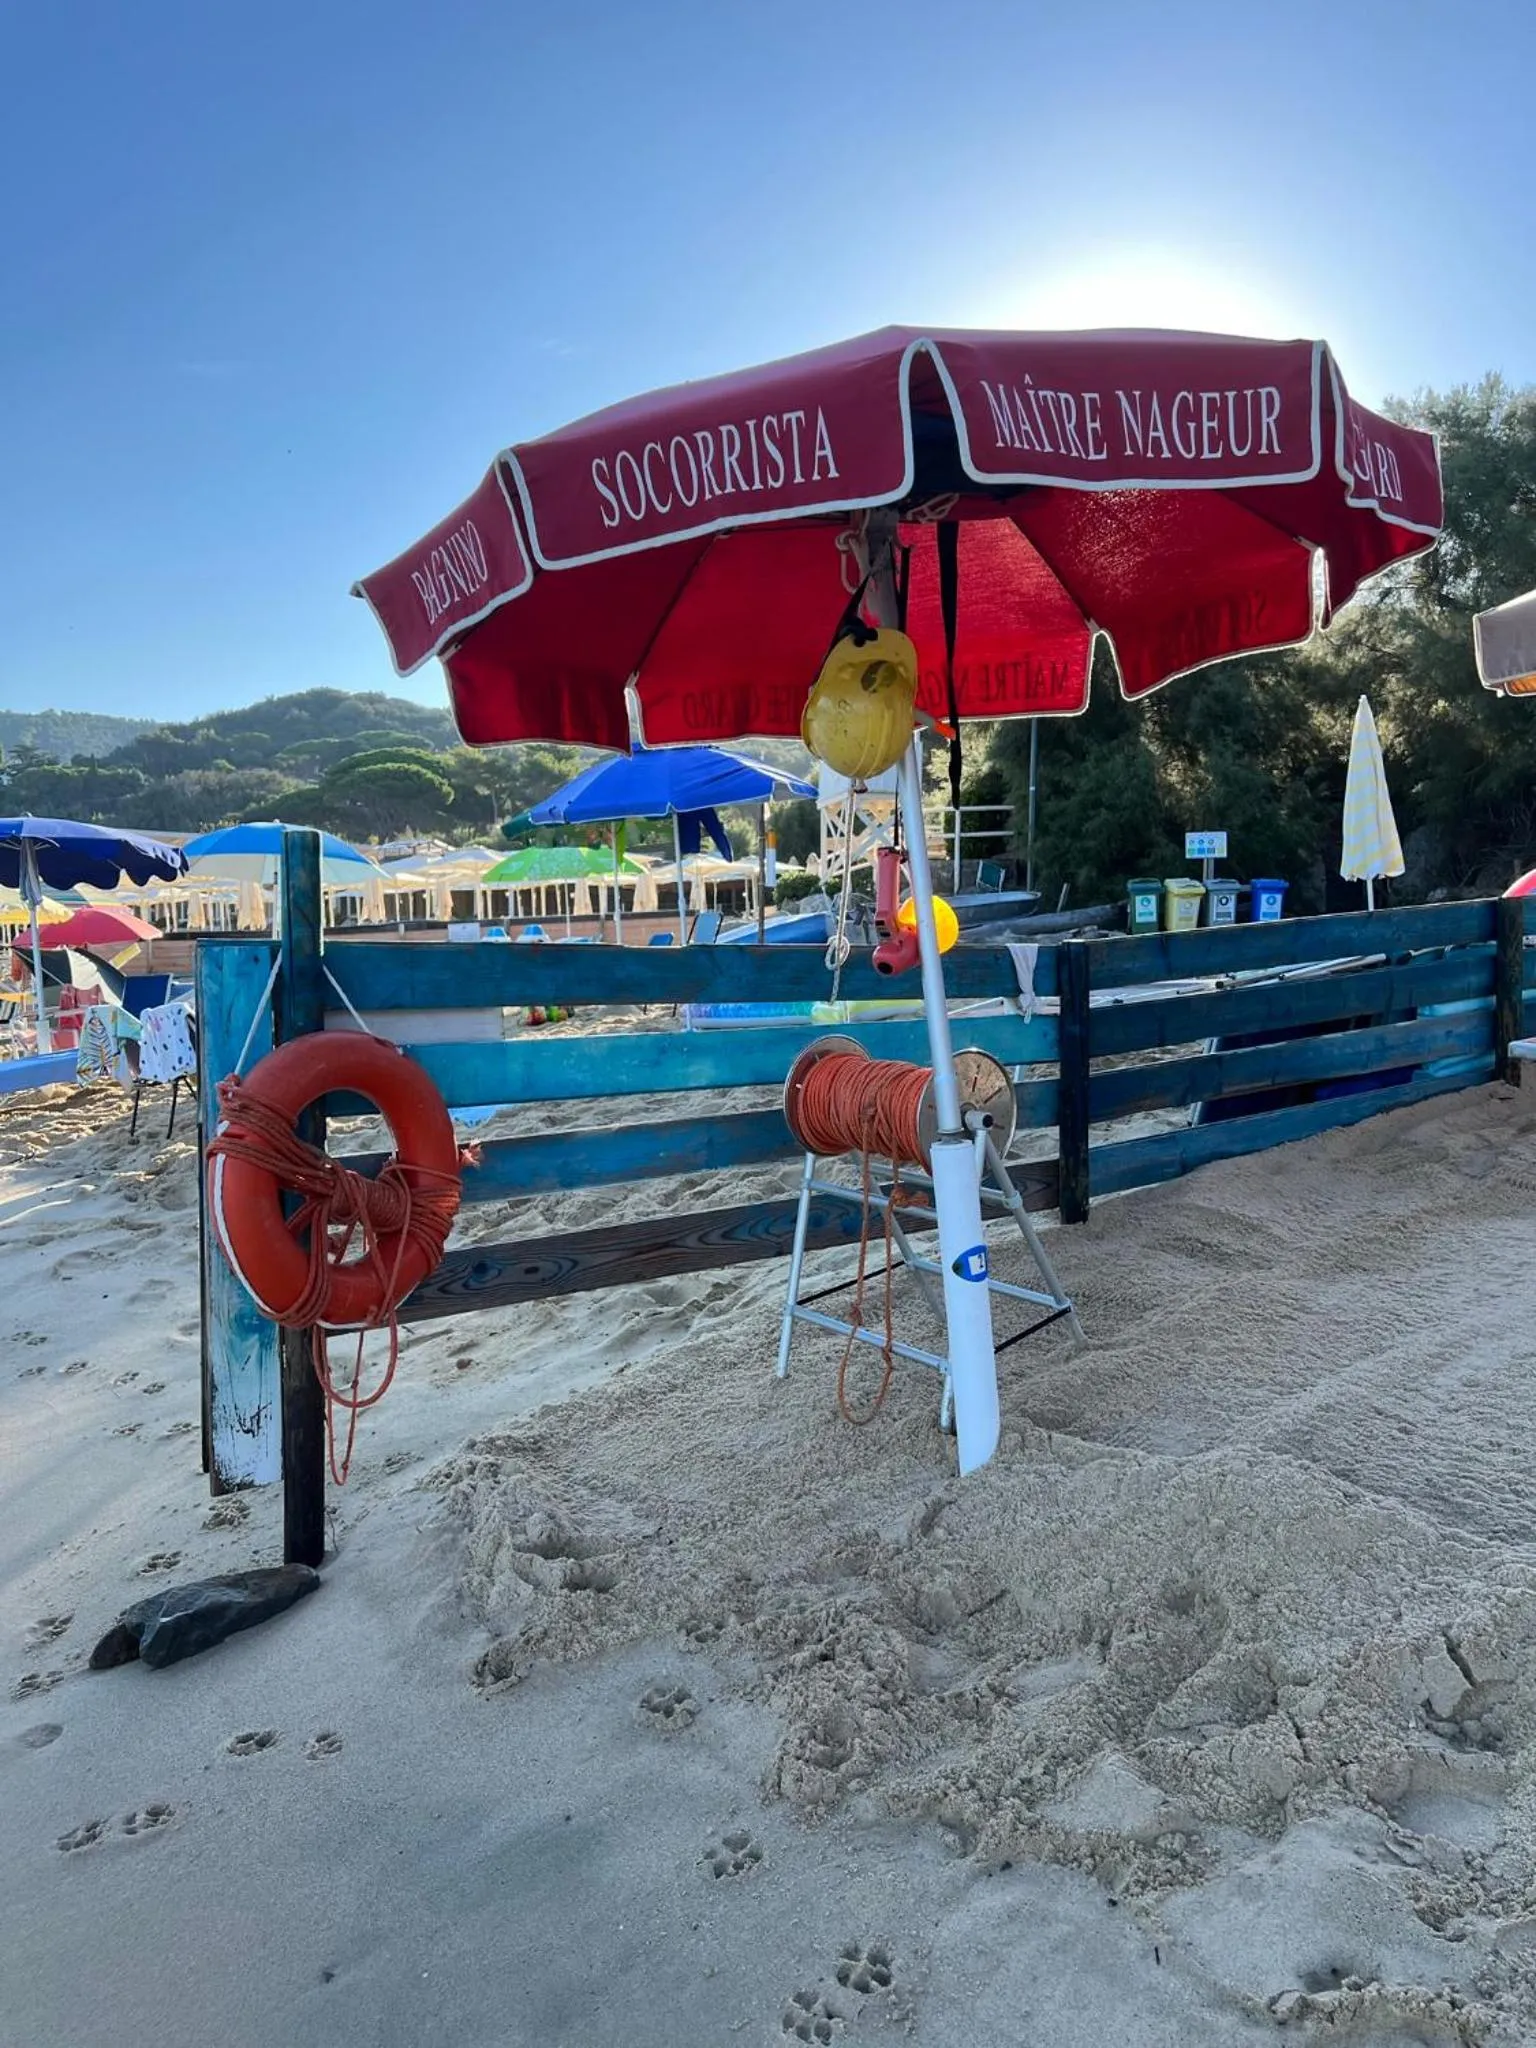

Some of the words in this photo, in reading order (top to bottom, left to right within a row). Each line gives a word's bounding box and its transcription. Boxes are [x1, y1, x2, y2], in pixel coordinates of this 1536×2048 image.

[591, 405, 840, 529] SOCORRISTA
[980, 373, 1107, 460] MAÎTRE
[1115, 386, 1282, 459] NAGEUR
